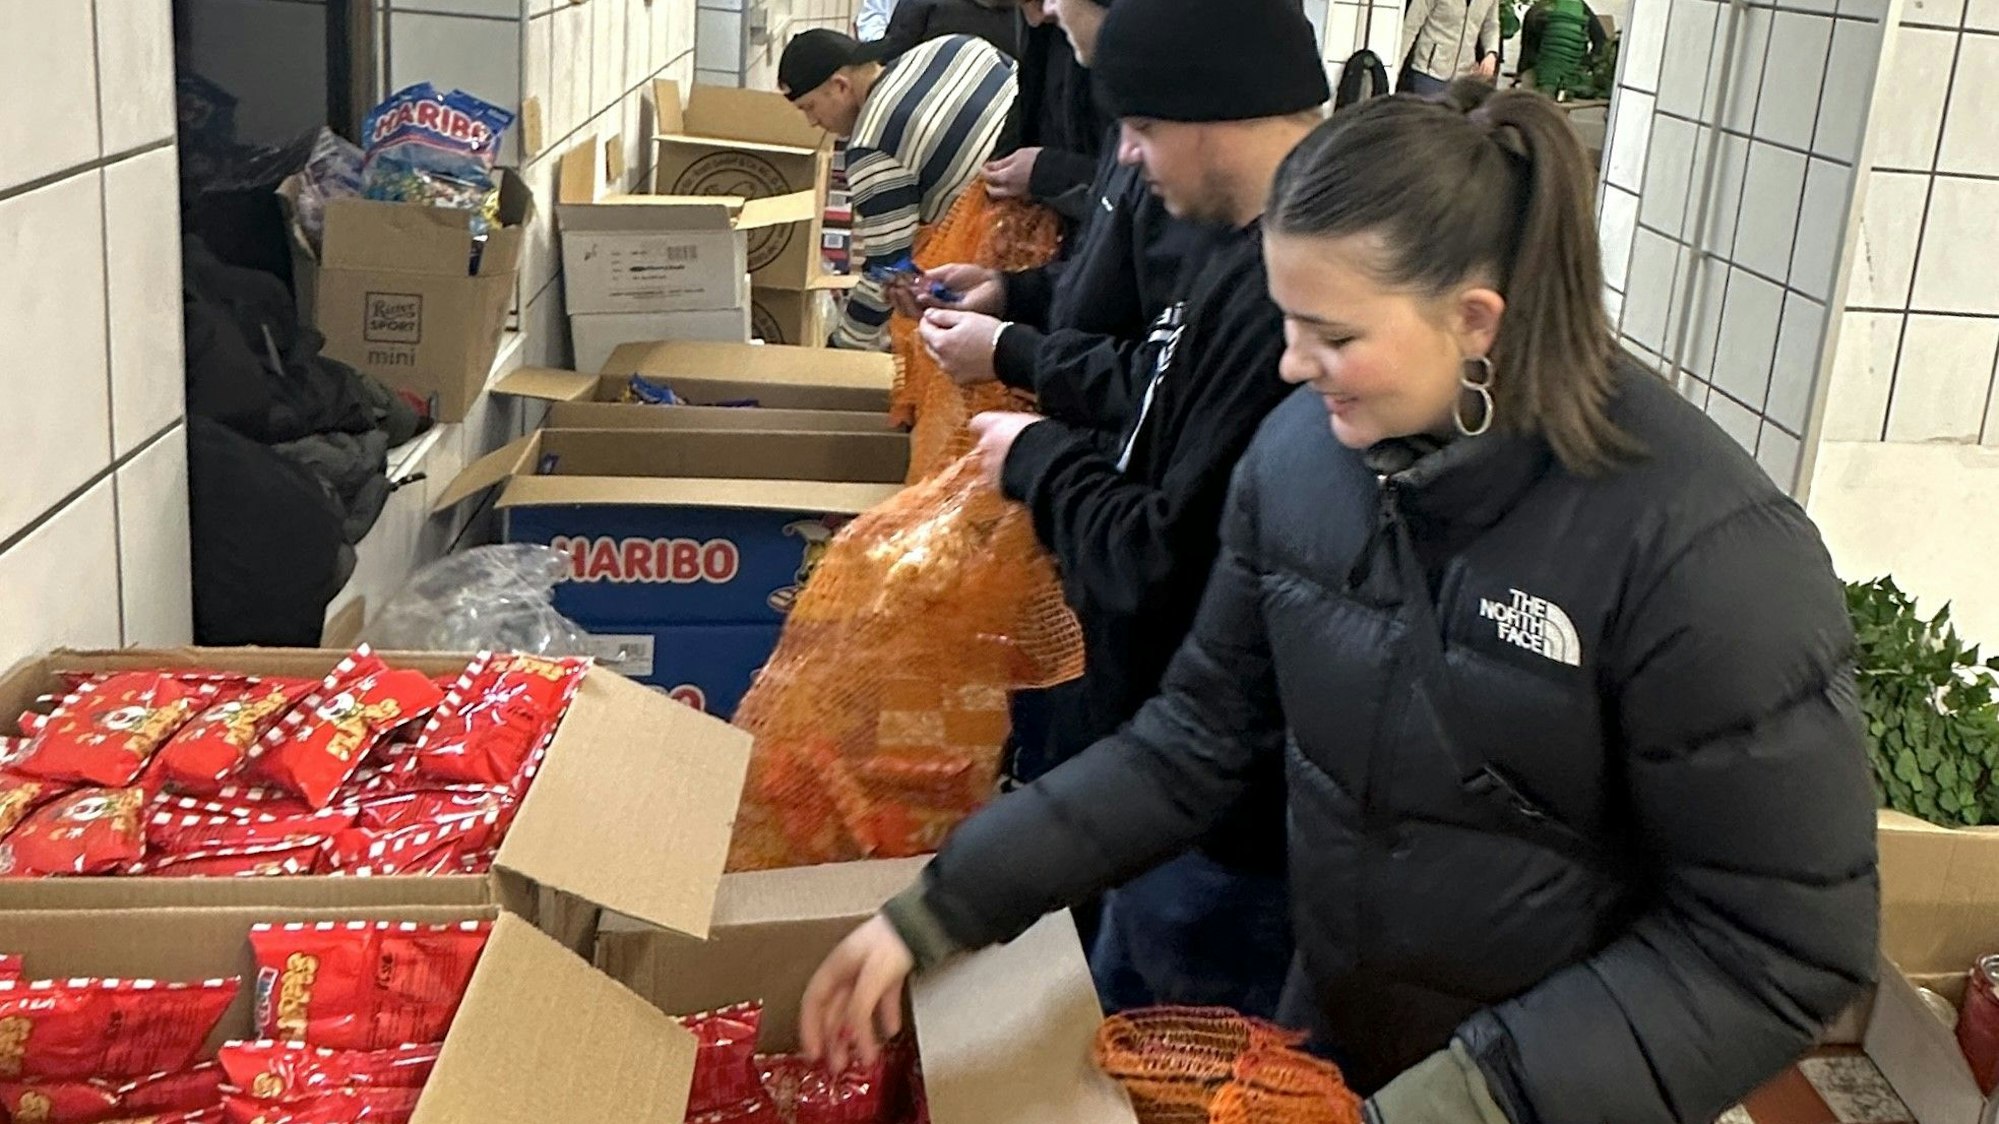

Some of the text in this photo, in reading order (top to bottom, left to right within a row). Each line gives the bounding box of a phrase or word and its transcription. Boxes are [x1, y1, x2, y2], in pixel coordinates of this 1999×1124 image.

[372, 99, 492, 147] HARIBO
[369, 320, 416, 331] SPORT
[367, 346, 416, 367] mini
[552, 536, 739, 584] HARIBO
[1480, 598, 1544, 637] NORTH
[1508, 588, 1547, 618] THE
[1497, 621, 1544, 656] FACE
